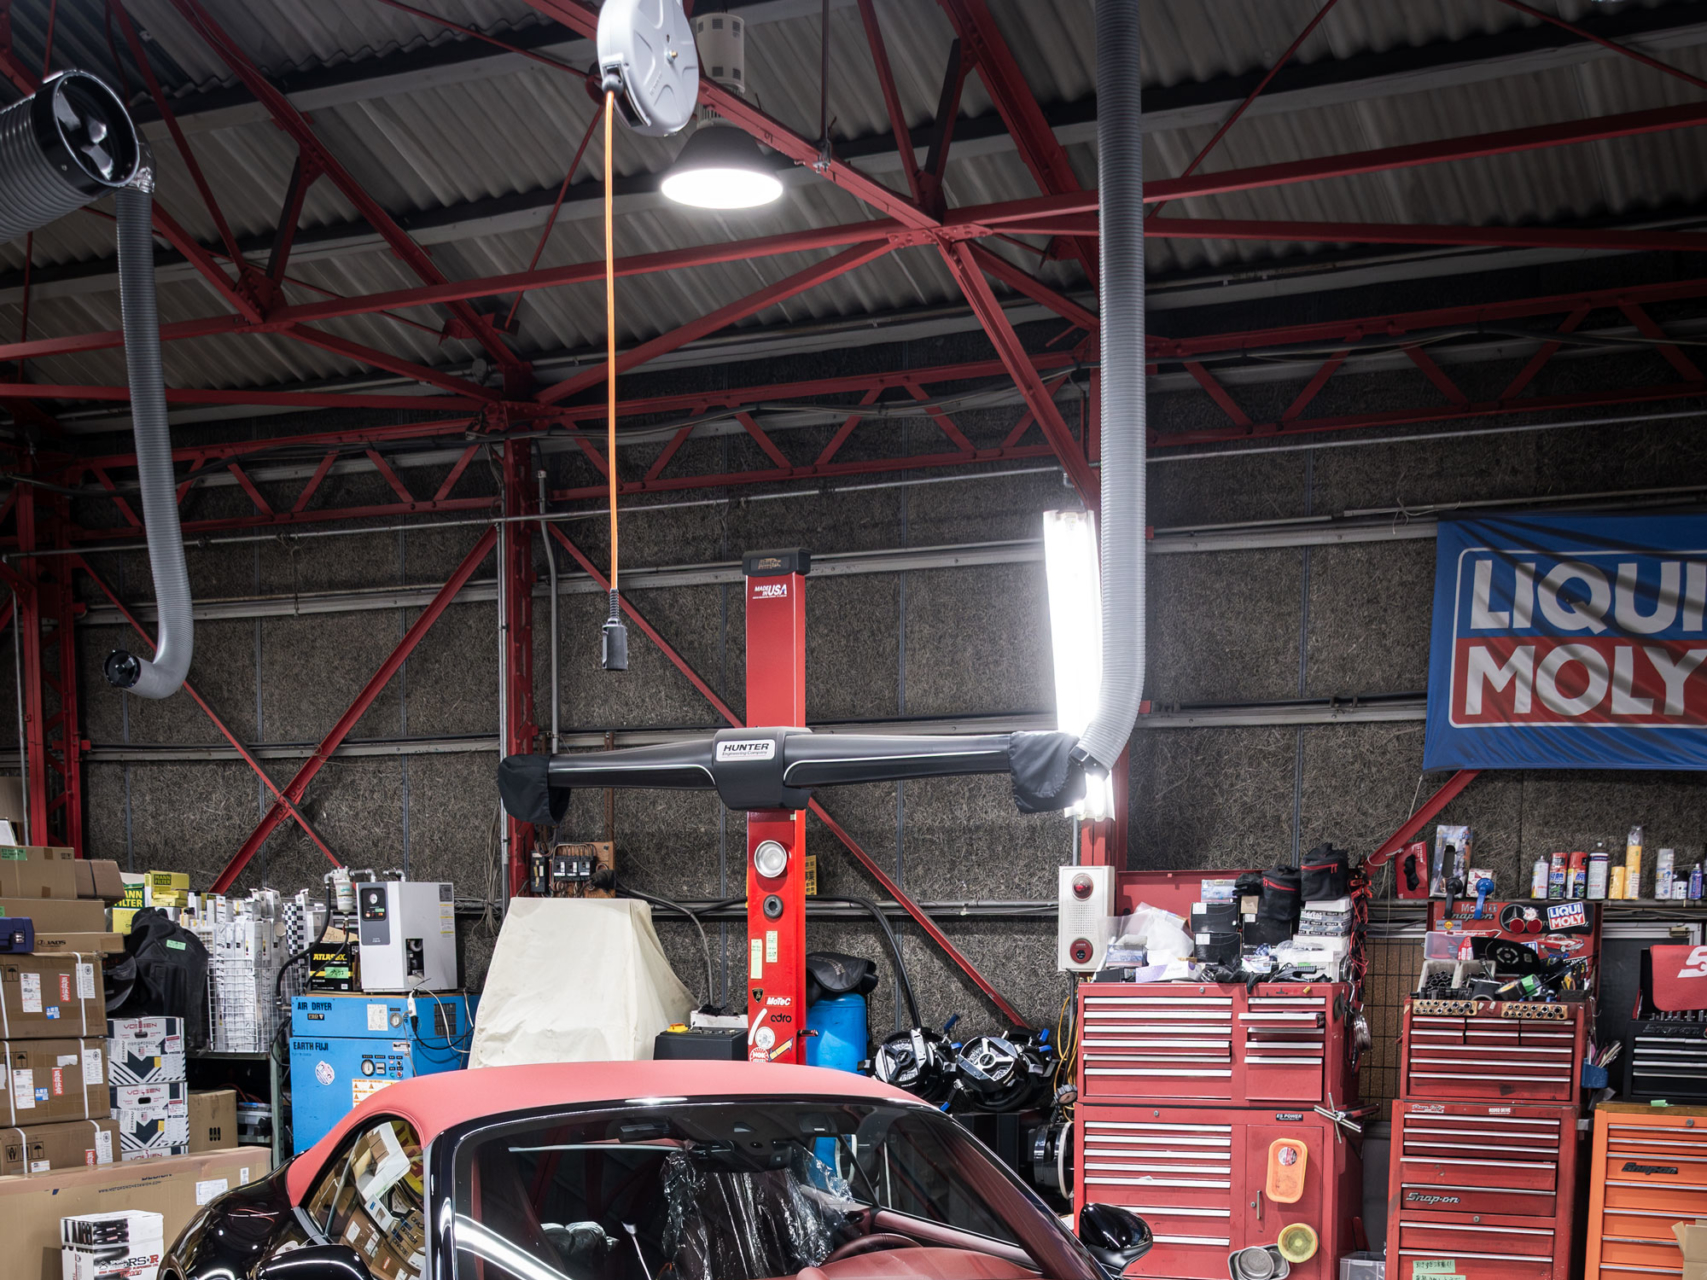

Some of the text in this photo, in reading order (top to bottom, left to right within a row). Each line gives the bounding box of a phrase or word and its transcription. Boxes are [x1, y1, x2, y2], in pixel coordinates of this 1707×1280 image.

[768, 584, 787, 596] USA
[1470, 560, 1707, 635] LIQUI
[1465, 643, 1707, 716] MOLY
[723, 743, 770, 752] HUNTER
[123, 889, 143, 899] ANN
[1461, 904, 1488, 912] Moil
[1549, 904, 1583, 918] LIQUI
[1551, 914, 1585, 928] MOLY
[313, 953, 347, 961] ATLASX
[297, 1002, 332, 1011] AIR DRYER
[766, 997, 791, 1006] MoTeC
[293, 1042, 329, 1051] EARTH FUJI
[1622, 1162, 1678, 1175] Snap-on
[1406, 1192, 1460, 1204] Snap-on
